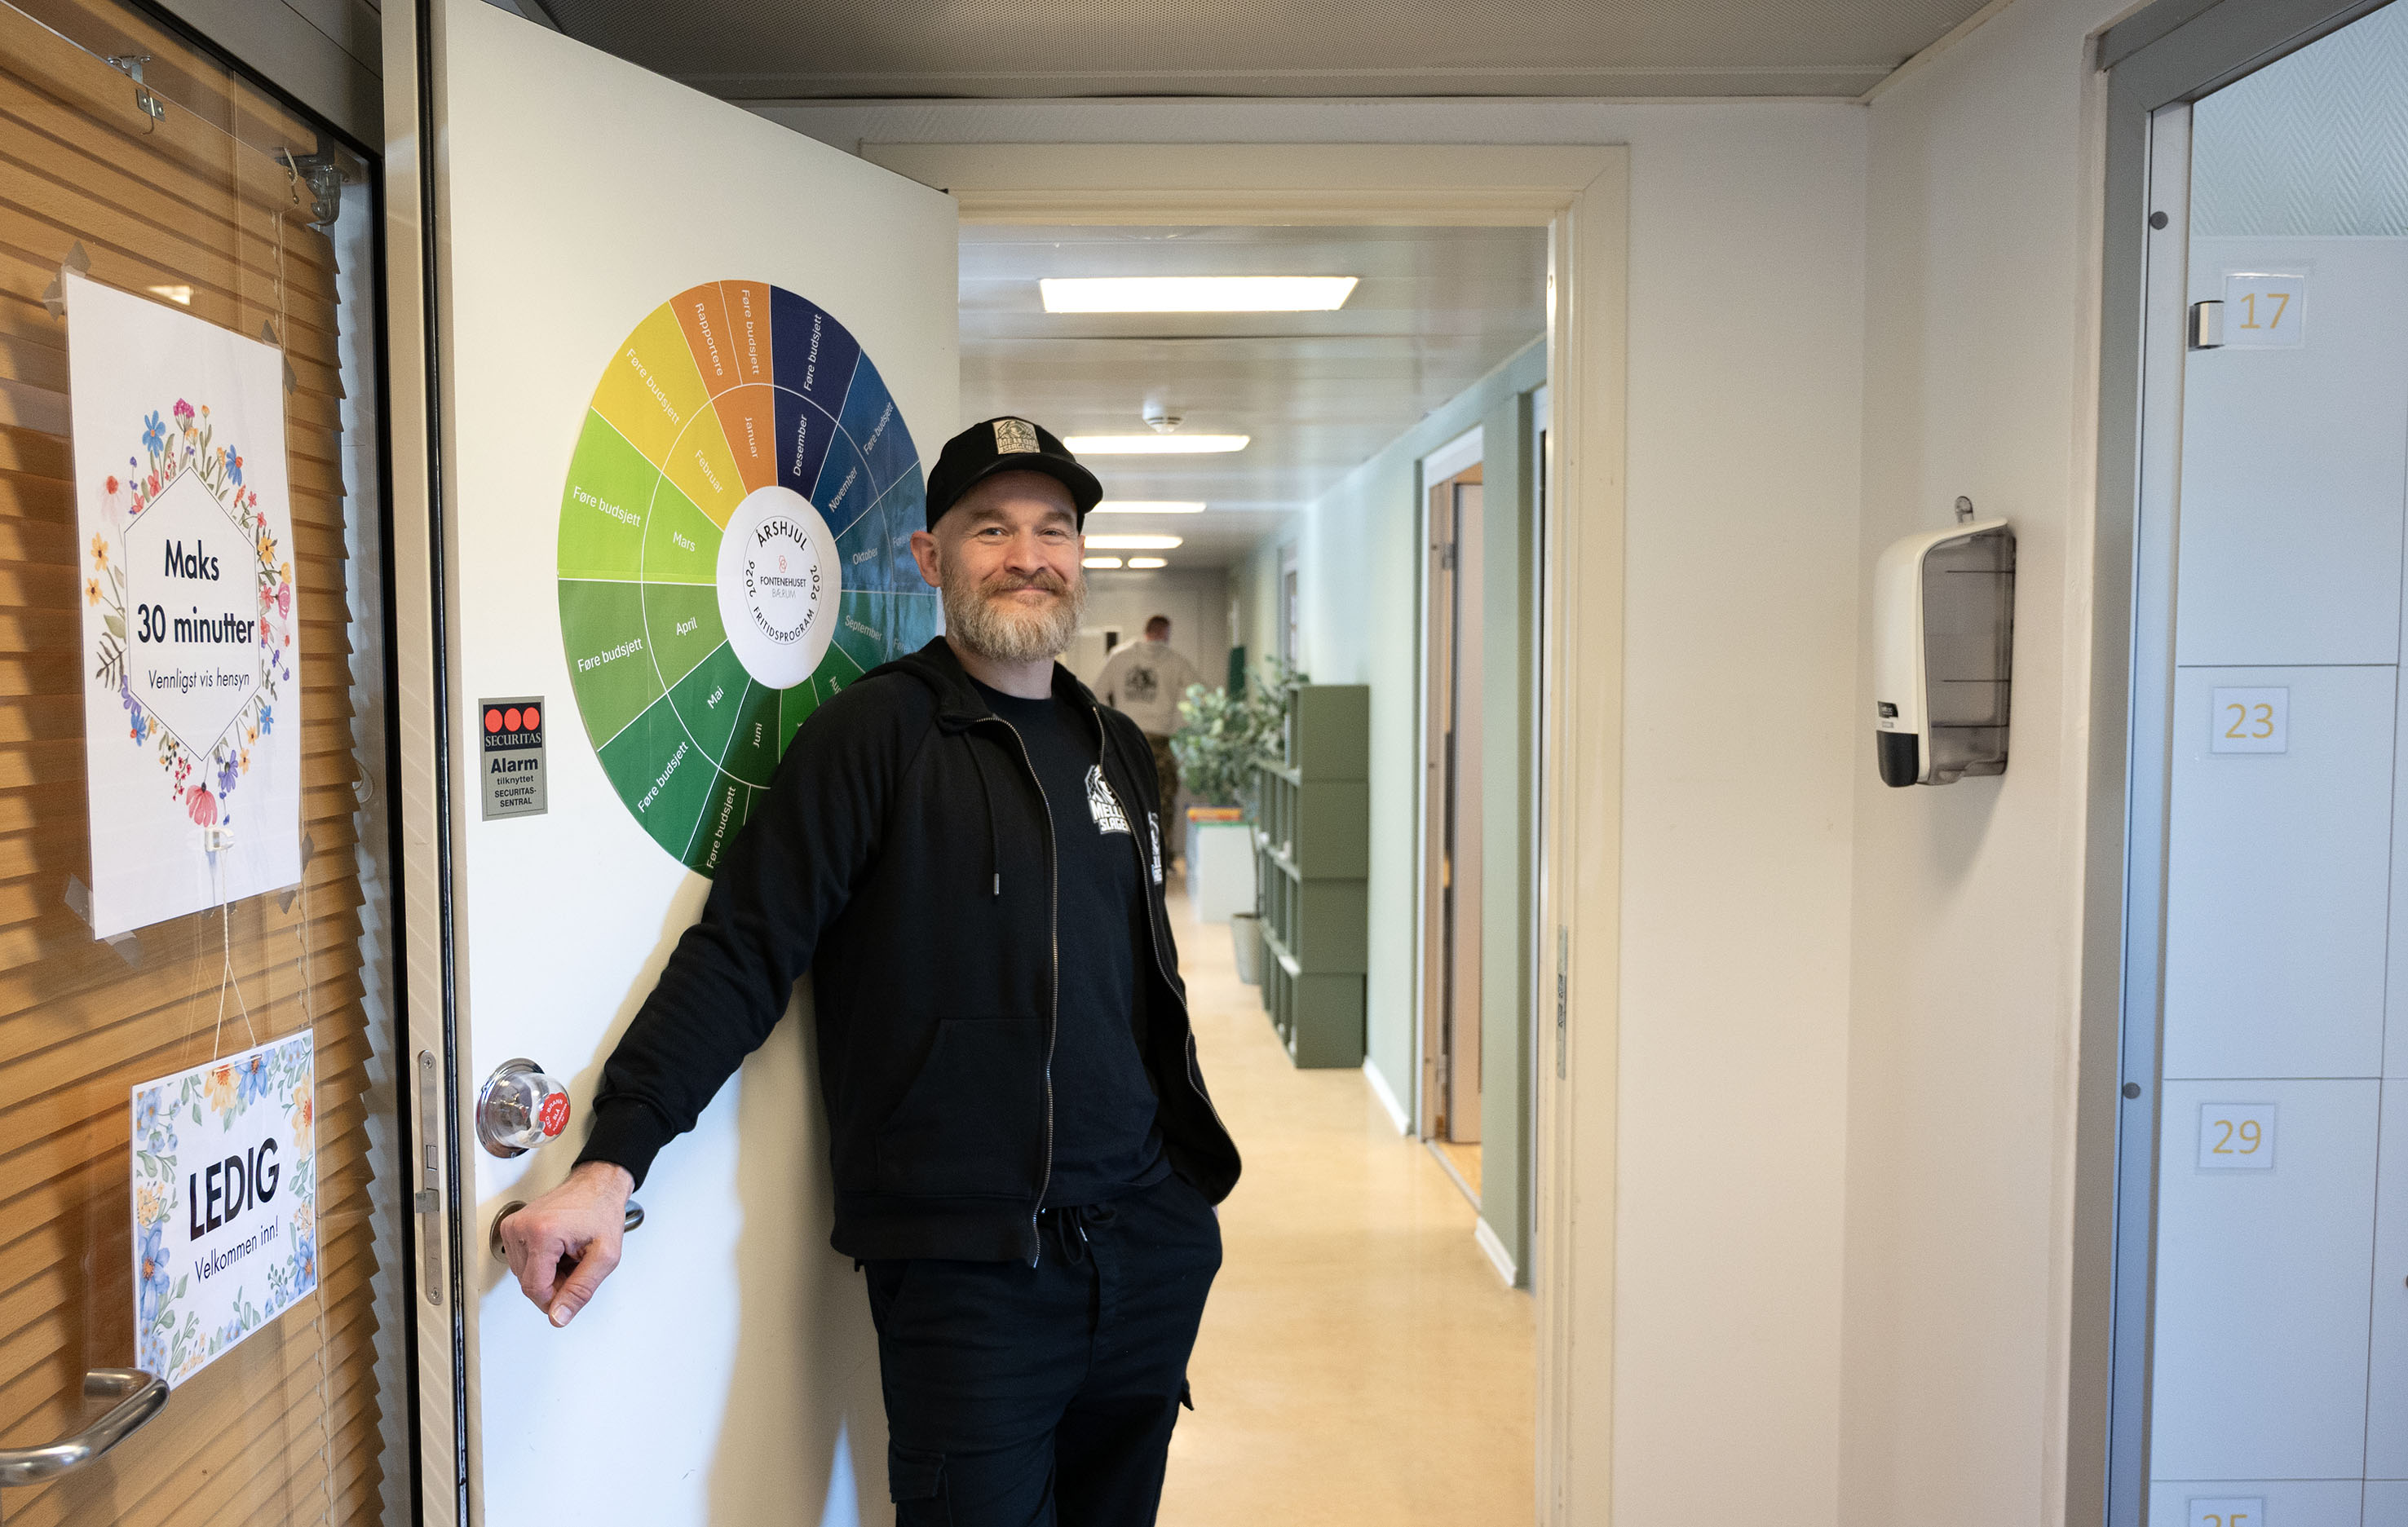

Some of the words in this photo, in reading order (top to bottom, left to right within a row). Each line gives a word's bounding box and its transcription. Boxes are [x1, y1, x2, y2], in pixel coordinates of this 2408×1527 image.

[741, 289, 752, 318] Føre
[2240, 293, 2290, 329] 17
[696, 302, 723, 376] Rapportere
[746, 321, 759, 374] budsjett
[808, 314, 822, 364] budsjett
[626, 348, 647, 377] Føre
[646, 376, 680, 425] budsjett
[803, 364, 815, 391] Føre
[744, 417, 758, 459] Januar
[793, 414, 808, 477] Desember
[863, 434, 877, 456] Føre
[874, 402, 894, 434] budsjett
[695, 450, 723, 493] Februar
[572, 486, 597, 507] Føre
[599, 497, 641, 527] budsjett
[828, 466, 858, 513] November
[673, 532, 696, 552] Mars
[756, 521, 807, 551] ÅRSHJUL
[165, 539, 219, 581] Maks
[852, 547, 878, 565] Oktober
[745, 559, 757, 598] 2026
[760, 576, 806, 587] FONTENEHUSET
[771, 589, 797, 598] BÆRUM
[810, 565, 820, 602] 2026
[138, 603, 166, 643] 30
[174, 606, 255, 644] minutter
[676, 617, 698, 636] April
[753, 606, 815, 642] FRITIDSPROGRAM
[845, 615, 882, 642] September
[577, 655, 601, 673] Føre
[602, 638, 643, 664] budsjett
[148, 668, 197, 694] Vennligst
[200, 670, 214, 687] vis
[217, 667, 250, 691] hensyn
[707, 686, 724, 709] Mai
[753, 722, 762, 748] Juni
[2225, 704, 2274, 739] 23
[485, 733, 541, 747] SECURITAS
[491, 757, 538, 774] Alarm
[497, 775, 534, 785] tilknyttet
[637, 785, 660, 813] Føre
[656, 741, 689, 788] budsjett
[494, 787, 537, 798] SECURITAS-
[500, 797, 532, 808] SENTRAL
[706, 841, 721, 869] Føre
[715, 786, 736, 838] budsjett
[2212, 1119, 2261, 1154] 29
[190, 1137, 280, 1242] LEDIG
[195, 1235, 258, 1284] Velkommen
[261, 1215, 279, 1247] inn!
